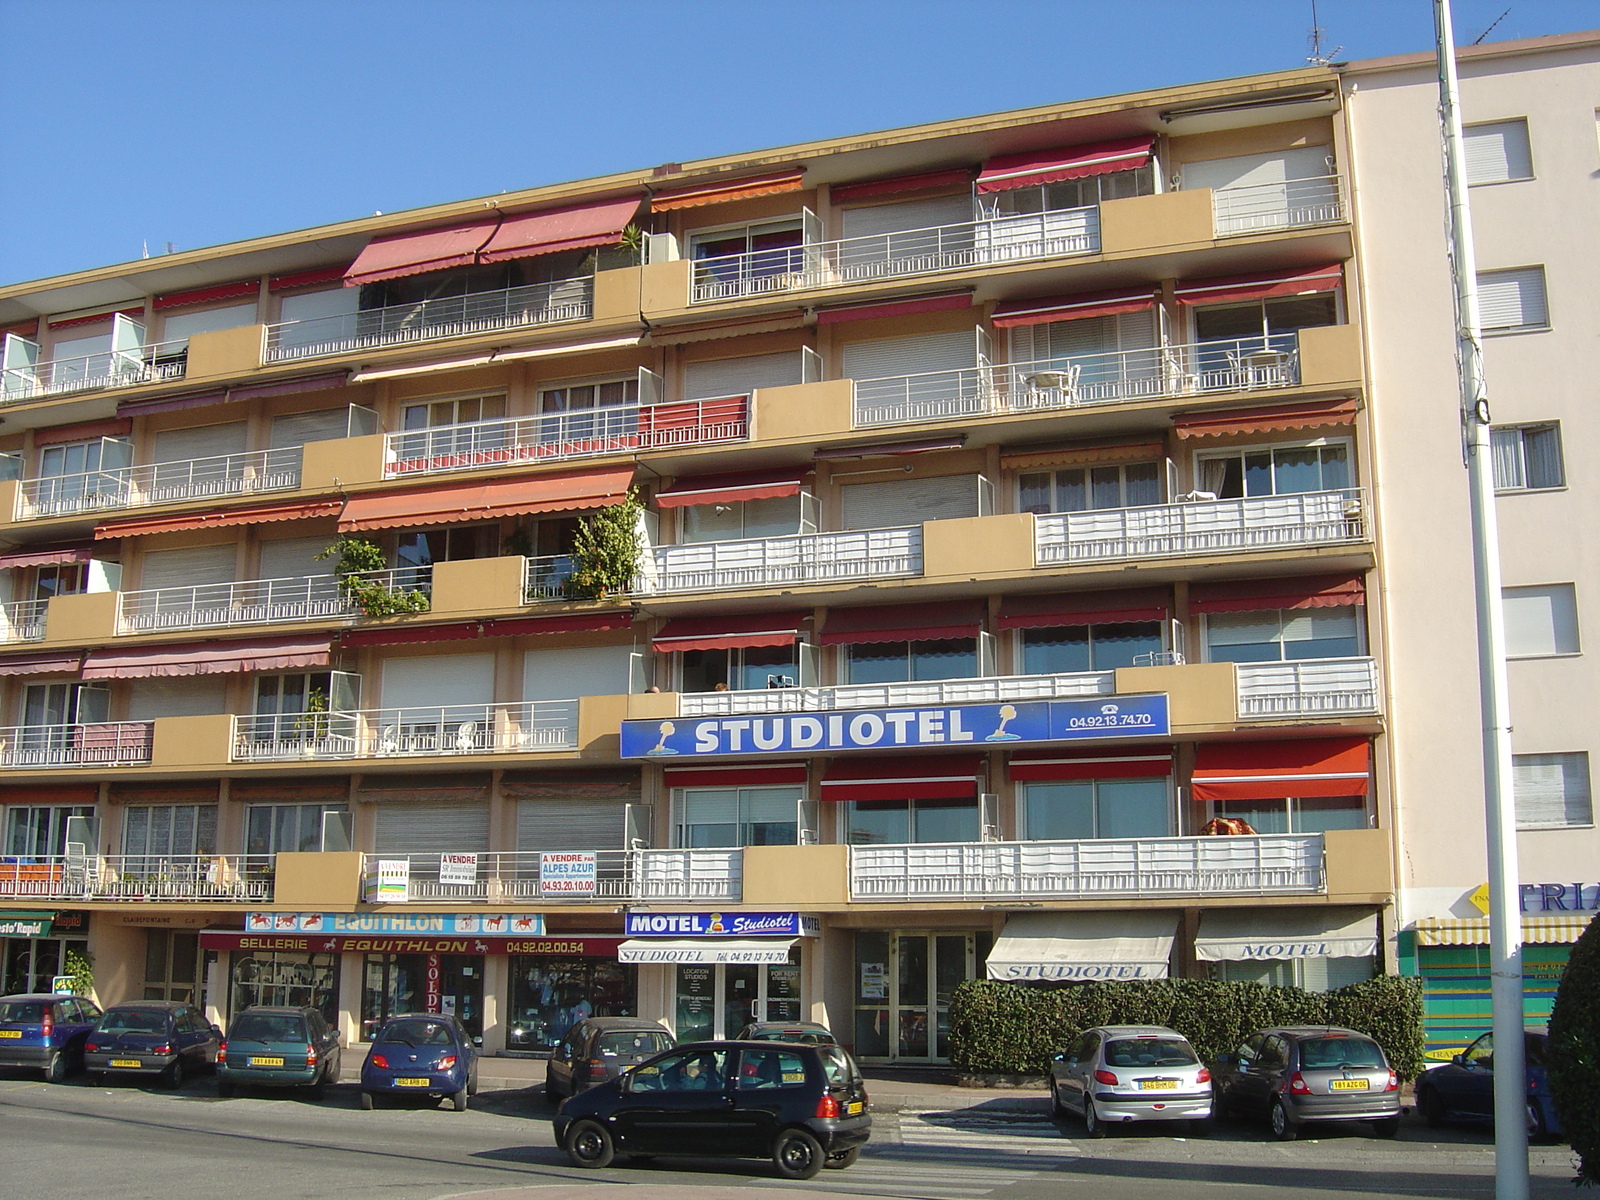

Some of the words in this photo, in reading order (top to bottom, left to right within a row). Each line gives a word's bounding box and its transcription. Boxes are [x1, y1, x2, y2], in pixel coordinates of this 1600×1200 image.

[695, 709, 975, 753] STUDIOTEL
[442, 855, 448, 863] A
[449, 855, 476, 864] VENDRE
[551, 854, 582, 862] VENDRE
[543, 864, 569, 873] ALPES
[571, 864, 594, 872] AZUR
[542, 880, 594, 891] 04.93.20.10.00
[334, 914, 443, 931] EQUITHLON
[630, 916, 703, 932] MOTEL
[732, 913, 793, 932] Studiotel
[802, 915, 821, 931] MOTEL
[239, 938, 308, 950] SELLERIE
[342, 940, 468, 952] EQUITHLON
[506, 942, 584, 954] 04.92.02.00.54
[1241, 942, 1332, 958] MOTEL
[621, 950, 704, 961] STUDIOTEL
[730, 953, 740, 961] 04
[742, 953, 751, 961] 92
[754, 953, 762, 961] 13
[763, 952, 772, 961] 74
[1006, 964, 1149, 979] STUDIOTEL
[1359, 1080, 1367, 1088] 06
